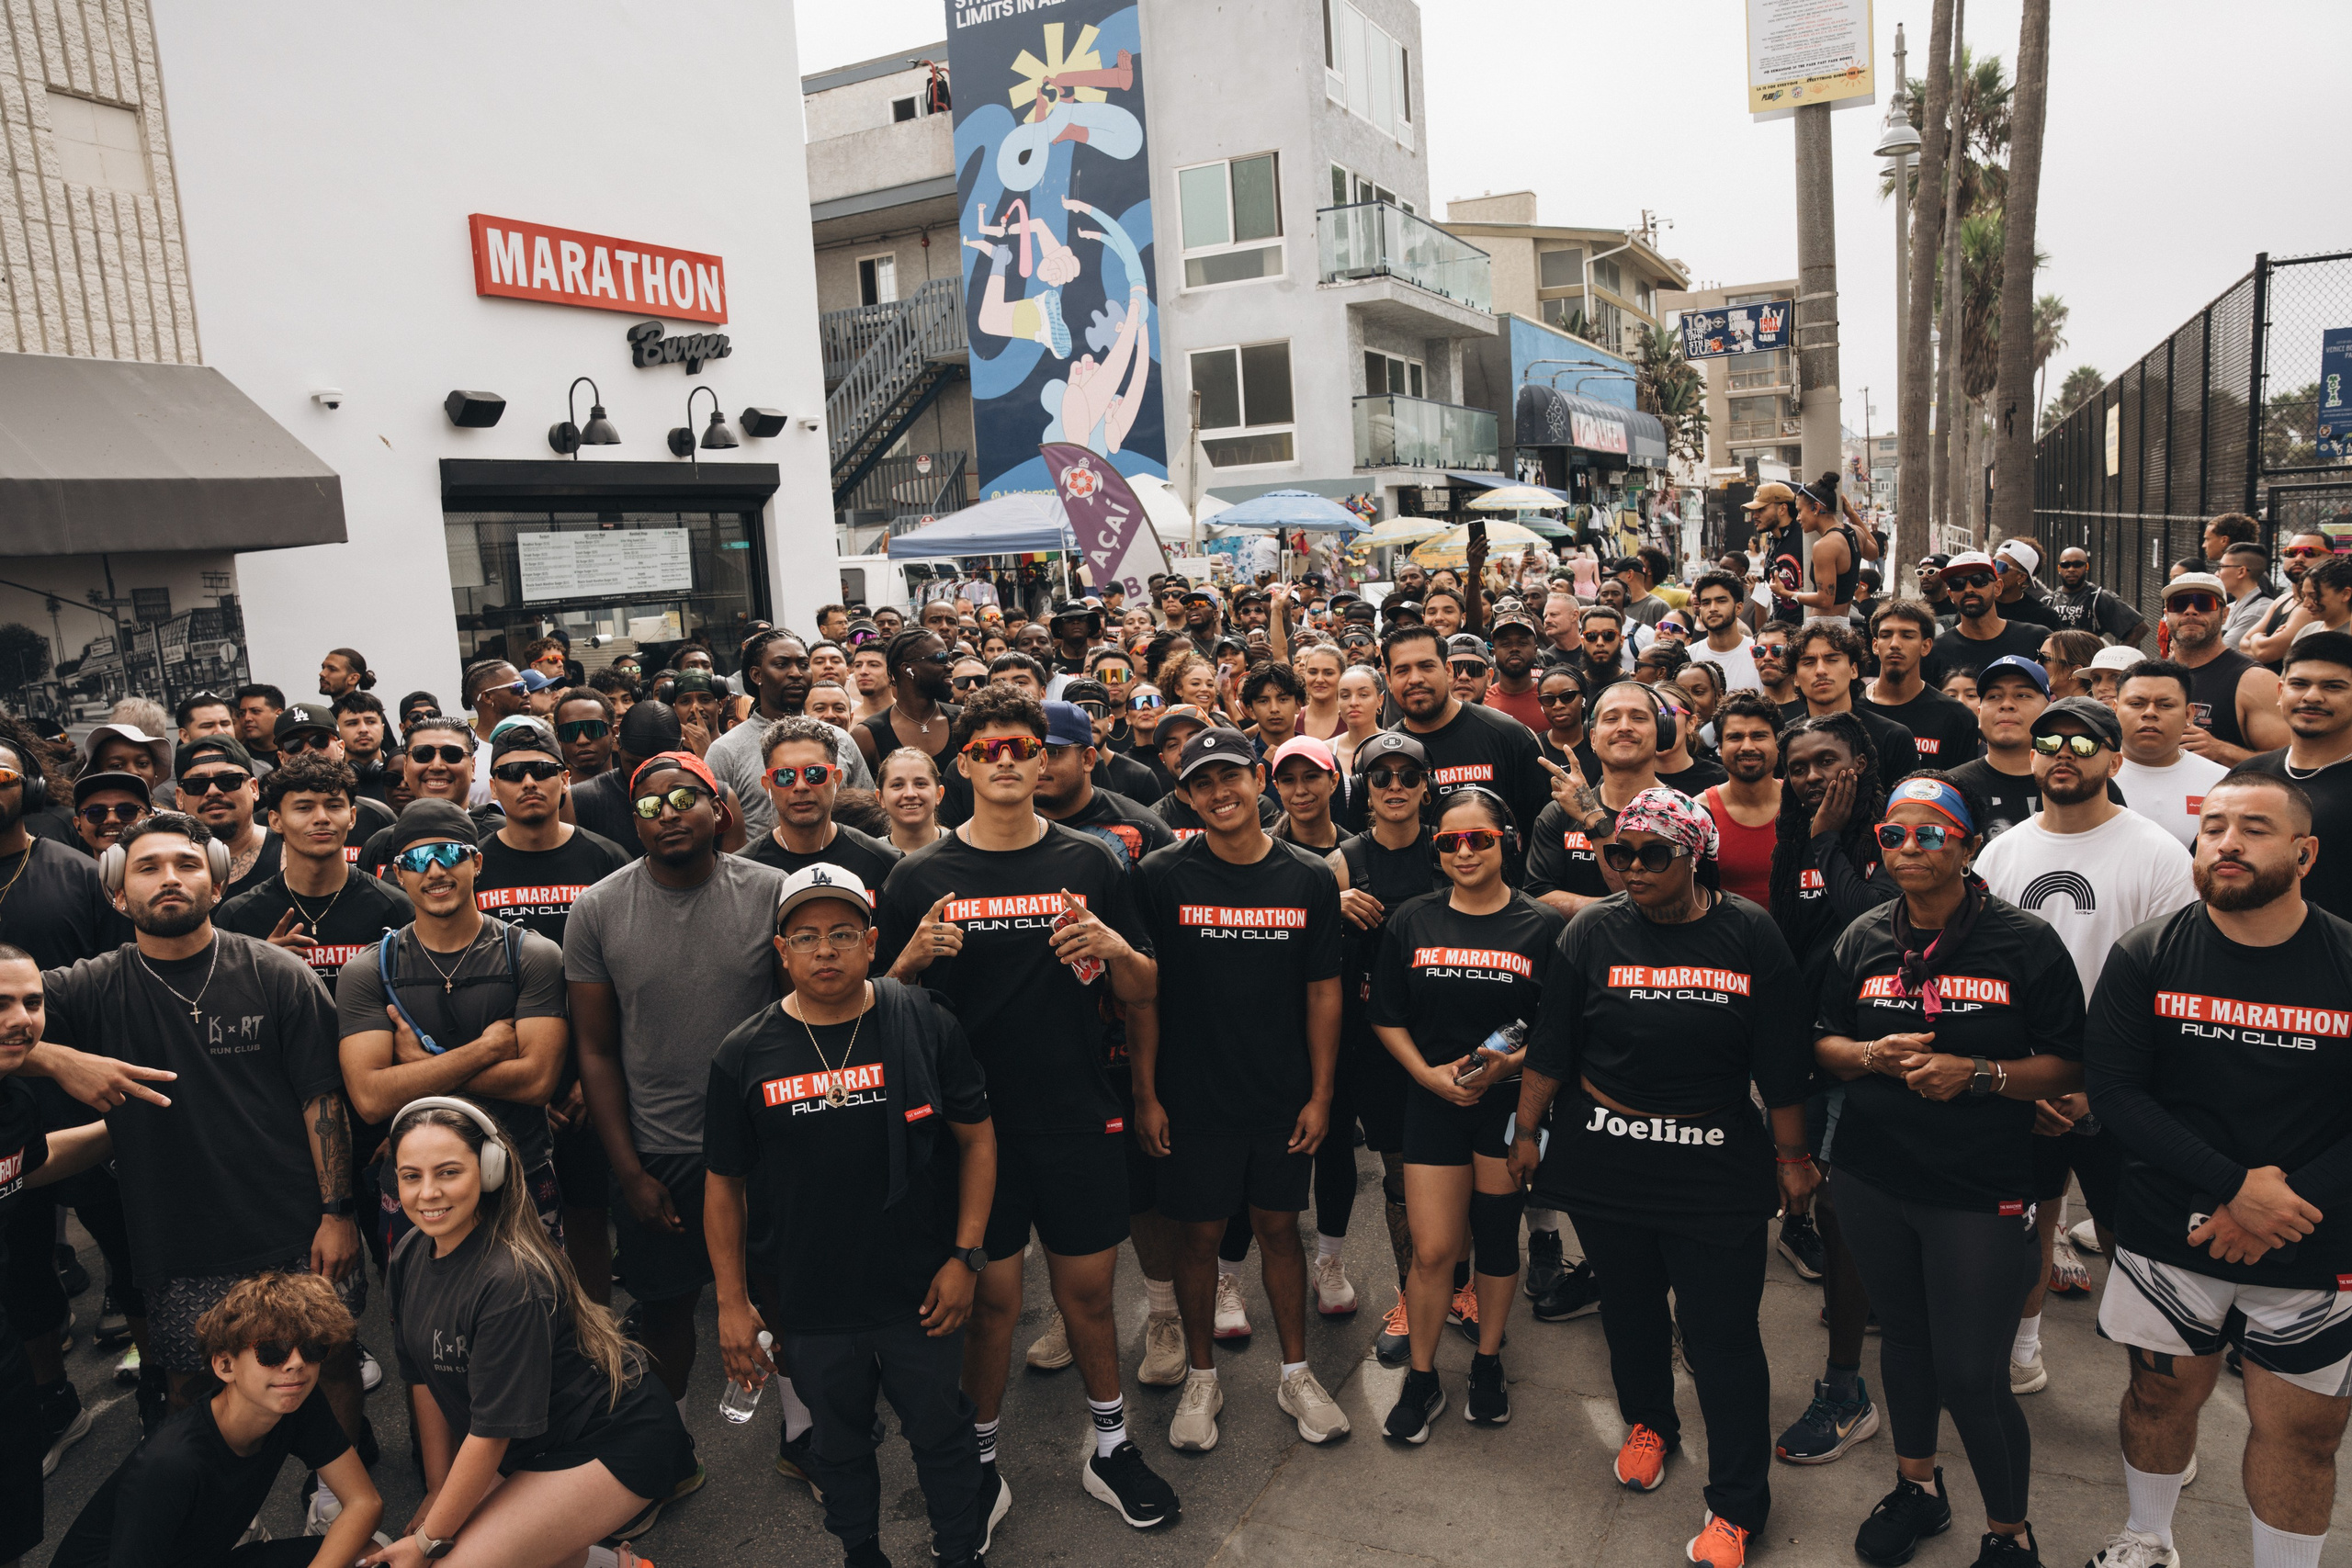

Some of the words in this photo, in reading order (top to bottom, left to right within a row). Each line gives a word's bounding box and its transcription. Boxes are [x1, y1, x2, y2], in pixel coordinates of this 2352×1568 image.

[956, 3, 1014, 28] LIMITS
[1017, 0, 1035, 14] IN
[486, 227, 721, 313] MARATHON
[628, 321, 731, 375] Burger
[2326, 344, 2345, 353] VENICE
[2328, 375, 2339, 401] MOTA
[1090, 498, 1130, 569] AÇAÍ
[292, 706, 310, 722] LA
[811, 867, 831, 886] LA
[480, 890, 510, 908] THE
[516, 886, 584, 904] MARATH
[946, 899, 981, 919] THE
[989, 896, 1085, 916] MARATHN
[499, 907, 535, 918] RUN
[1182, 907, 1214, 924] THE
[1220, 908, 1306, 927] MARATHON
[967, 919, 1009, 931] RUN
[1201, 929, 1238, 939] RUN
[1242, 930, 1289, 940] CLUB
[1416, 949, 1440, 965] THE
[1444, 950, 1530, 976] MARATHON
[1426, 967, 1462, 978] RUN
[1465, 969, 1513, 984] CLUB
[1611, 967, 1645, 986] THE
[1652, 968, 1747, 994] MARATHON
[1630, 989, 1670, 999] RUN
[1676, 989, 1729, 1004] CLUB
[1862, 977, 1893, 997] THE
[1873, 998, 1917, 1010] RUN
[2158, 993, 2202, 1019] THE
[2211, 999, 2350, 1036] MARATHON
[241, 1015, 265, 1041] RT
[2181, 1022, 2235, 1041] RUN
[2242, 1031, 2317, 1051] CLUB
[234, 1043, 261, 1054] CLUB
[765, 1082, 806, 1104] THE
[1586, 1107, 1724, 1146] Joeline
[434, 1364, 454, 1372] RUN
